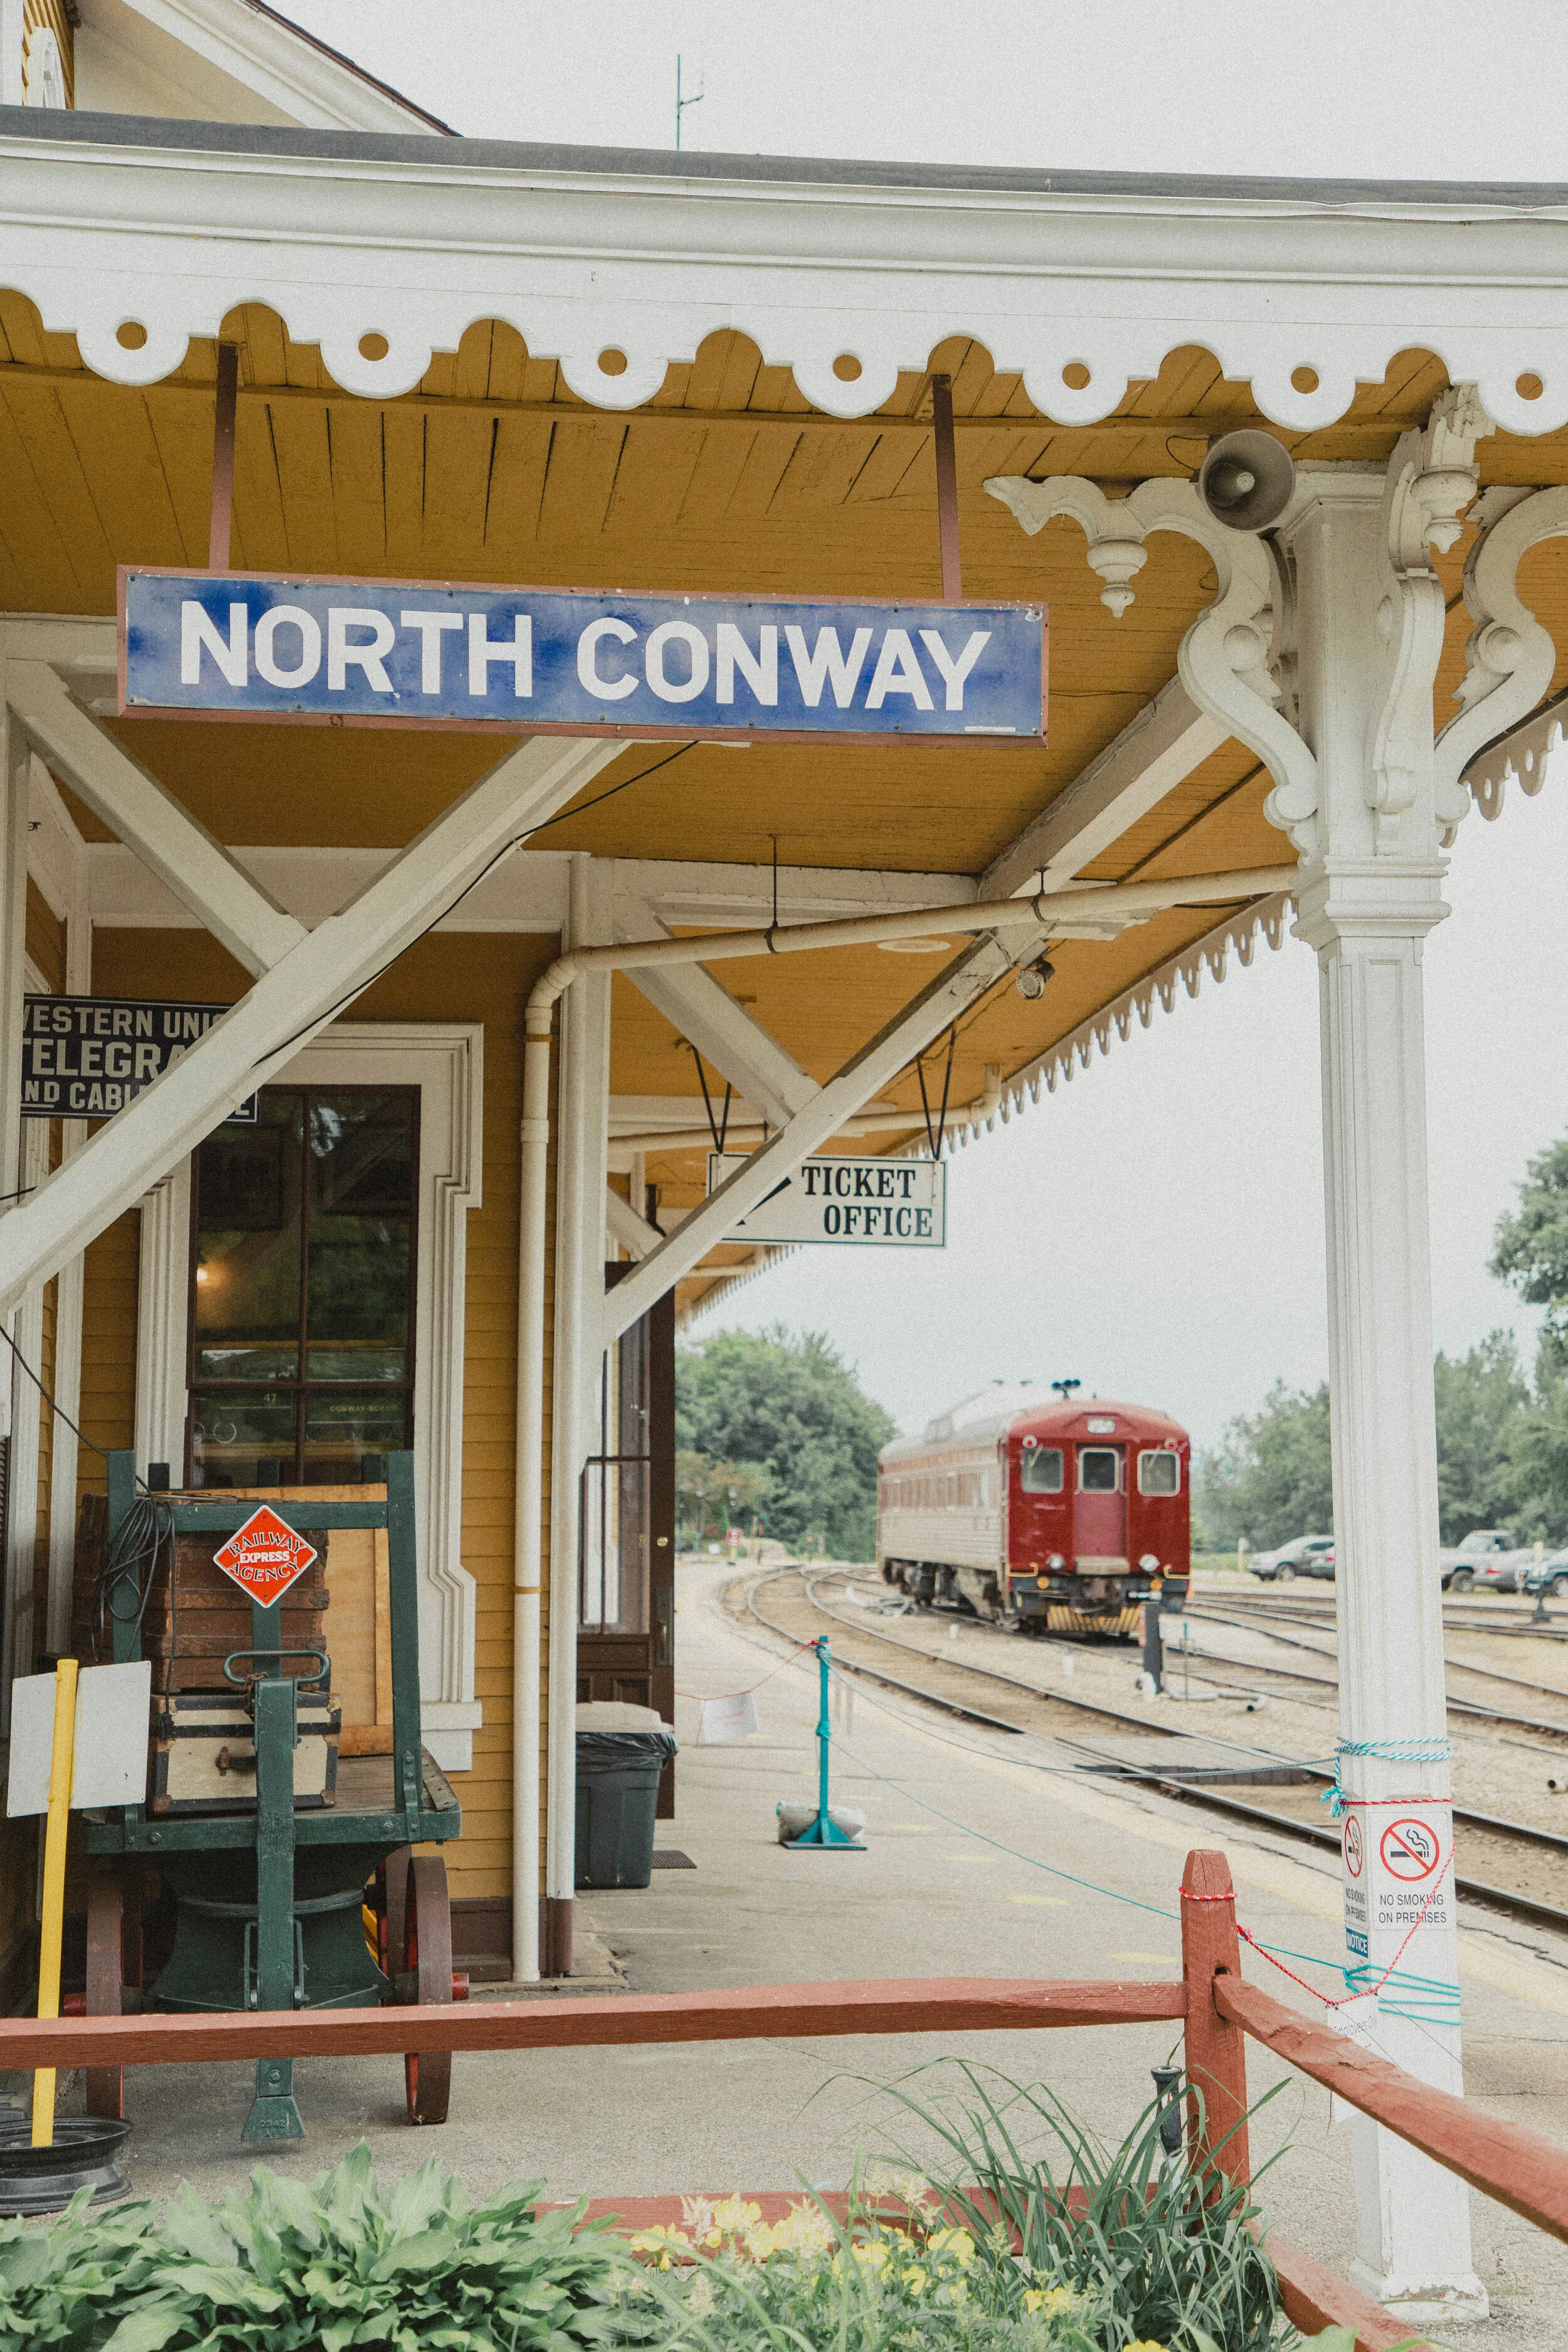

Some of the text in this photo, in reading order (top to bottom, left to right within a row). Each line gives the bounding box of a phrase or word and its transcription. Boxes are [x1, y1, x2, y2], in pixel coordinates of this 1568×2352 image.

[180, 600, 992, 711] NORTH CONWAY
[164, 1010, 225, 1039] UNI
[22, 1080, 148, 1111] ND CABL
[802, 1166, 916, 1198] TICKET
[824, 1205, 932, 1237] OFFICE
[263, 1393, 277, 1402] 47
[228, 1531, 307, 1557] RAILWAY
[226, 1556, 300, 1582] AGENCY
[240, 1551, 290, 1564] EXPRESS
[1345, 1887, 1351, 1899] NO
[1380, 1894, 1394, 1905] NO
[1345, 1904, 1351, 1915] ON
[1379, 1912, 1447, 1924] ON PREMISES
[1347, 1931, 1368, 1954] NOTICE
